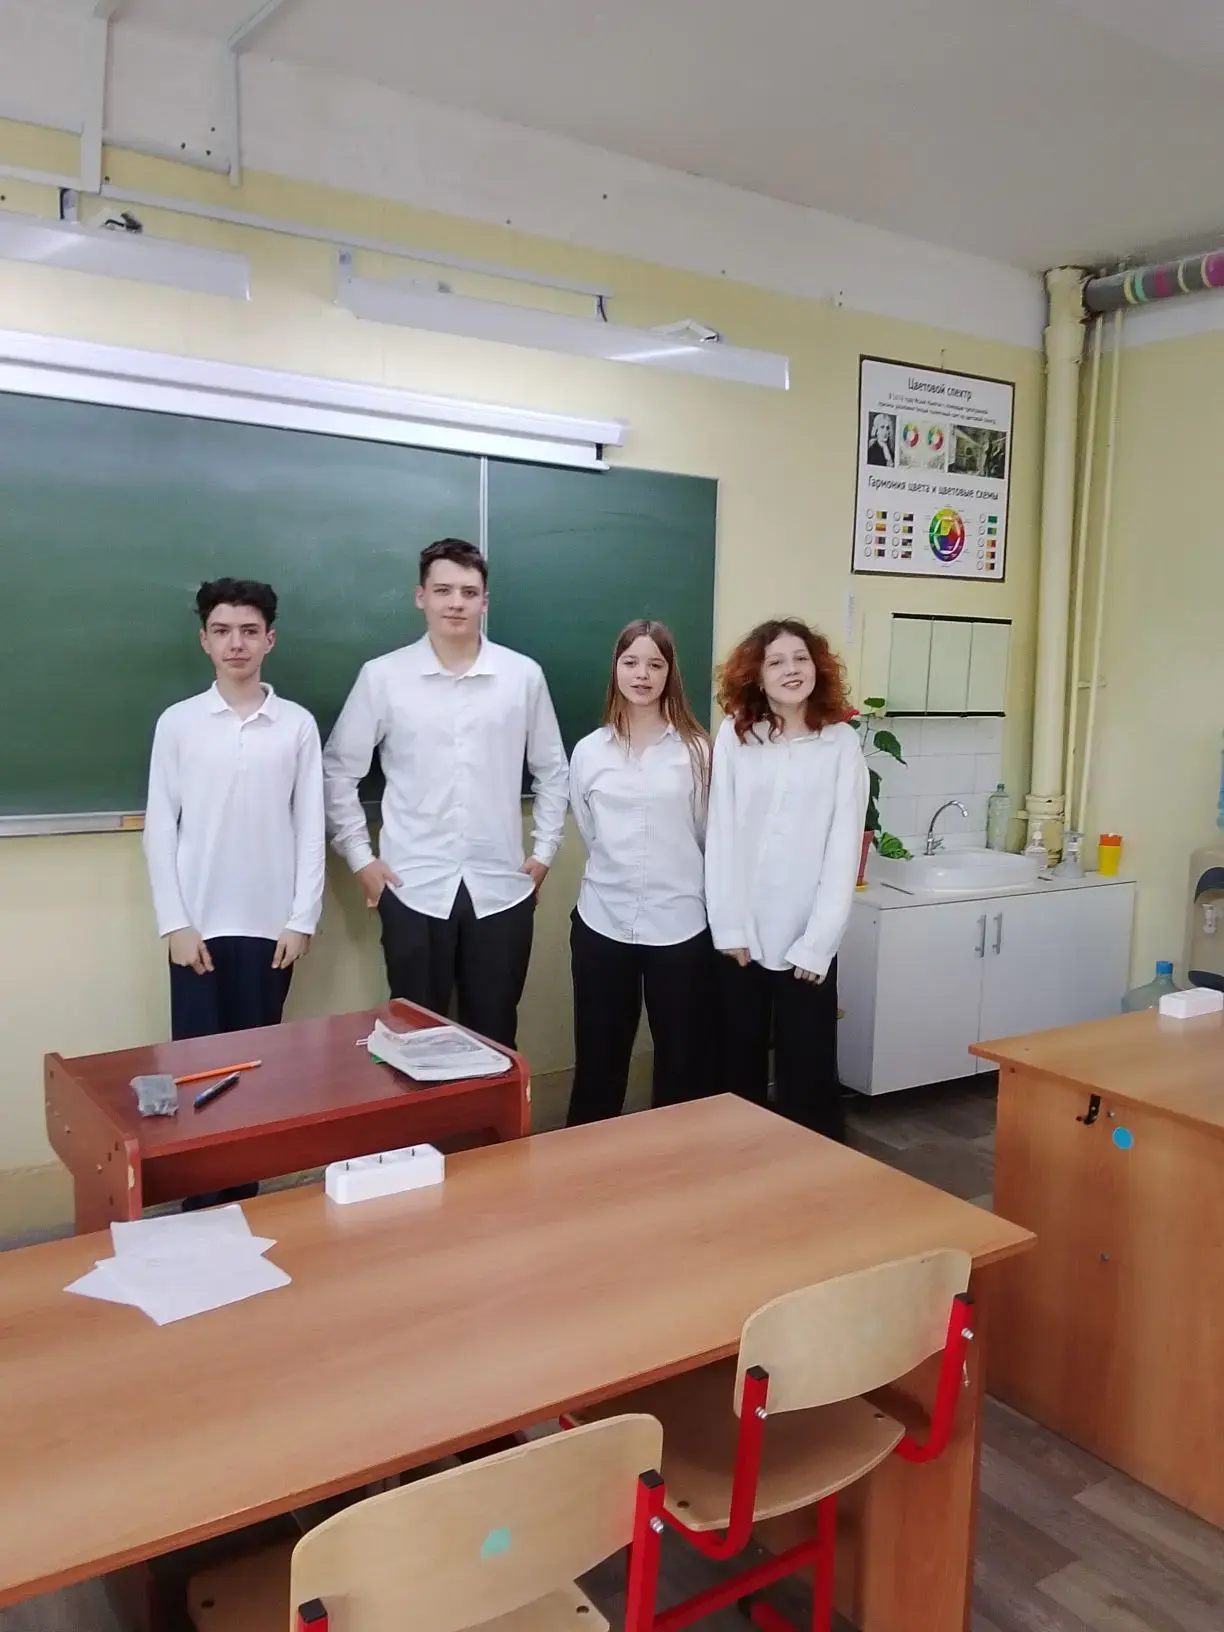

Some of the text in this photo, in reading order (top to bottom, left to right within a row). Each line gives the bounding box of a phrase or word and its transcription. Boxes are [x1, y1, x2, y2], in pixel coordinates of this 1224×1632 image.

[908, 377, 972, 401] Цветовой спектр
[868, 475, 906, 490] Гармония
[908, 483, 930, 493] цвета
[938, 486, 974, 498] цветовые
[975, 489, 999, 500] схемы
